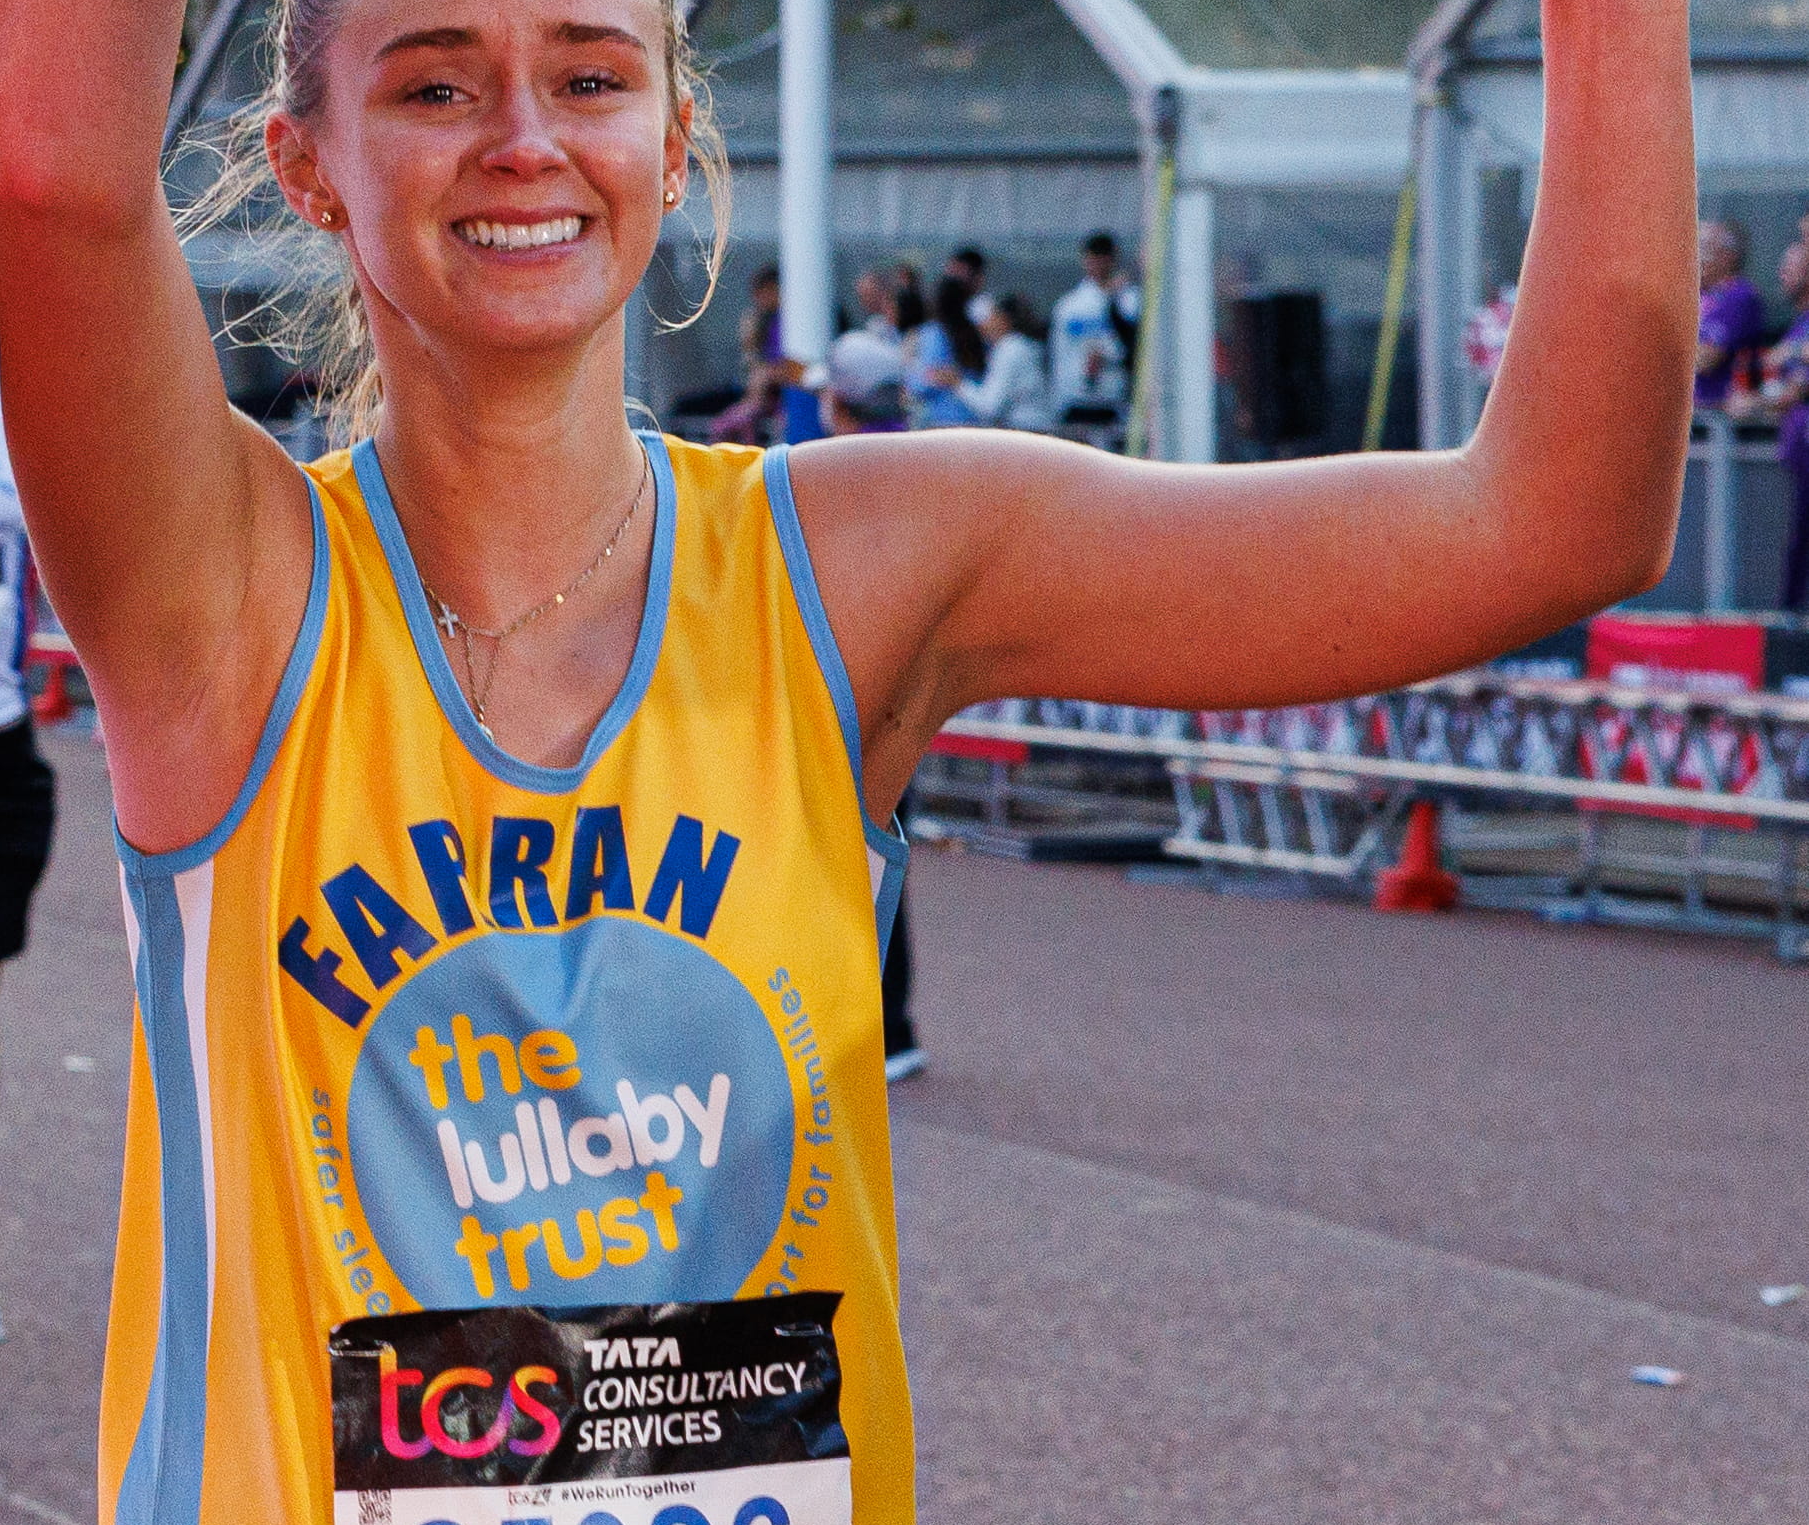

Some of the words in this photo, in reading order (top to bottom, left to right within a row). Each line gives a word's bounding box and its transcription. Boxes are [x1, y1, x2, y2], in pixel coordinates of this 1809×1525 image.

[409, 1015, 581, 1110] the
[767, 965, 834, 1145] families
[435, 1073, 731, 1209] lullaby
[311, 1087, 346, 1210] safer
[333, 1228, 392, 1316] slee
[455, 1172, 683, 1298] trust
[790, 1163, 833, 1227] for
[583, 1363, 807, 1411] CONSULTANCY
[584, 1337, 682, 1368] TATA
[380, 1347, 561, 1459] tcs
[577, 1411, 722, 1453] SERVICES
[561, 1479, 697, 1502] #WeRunTogether
